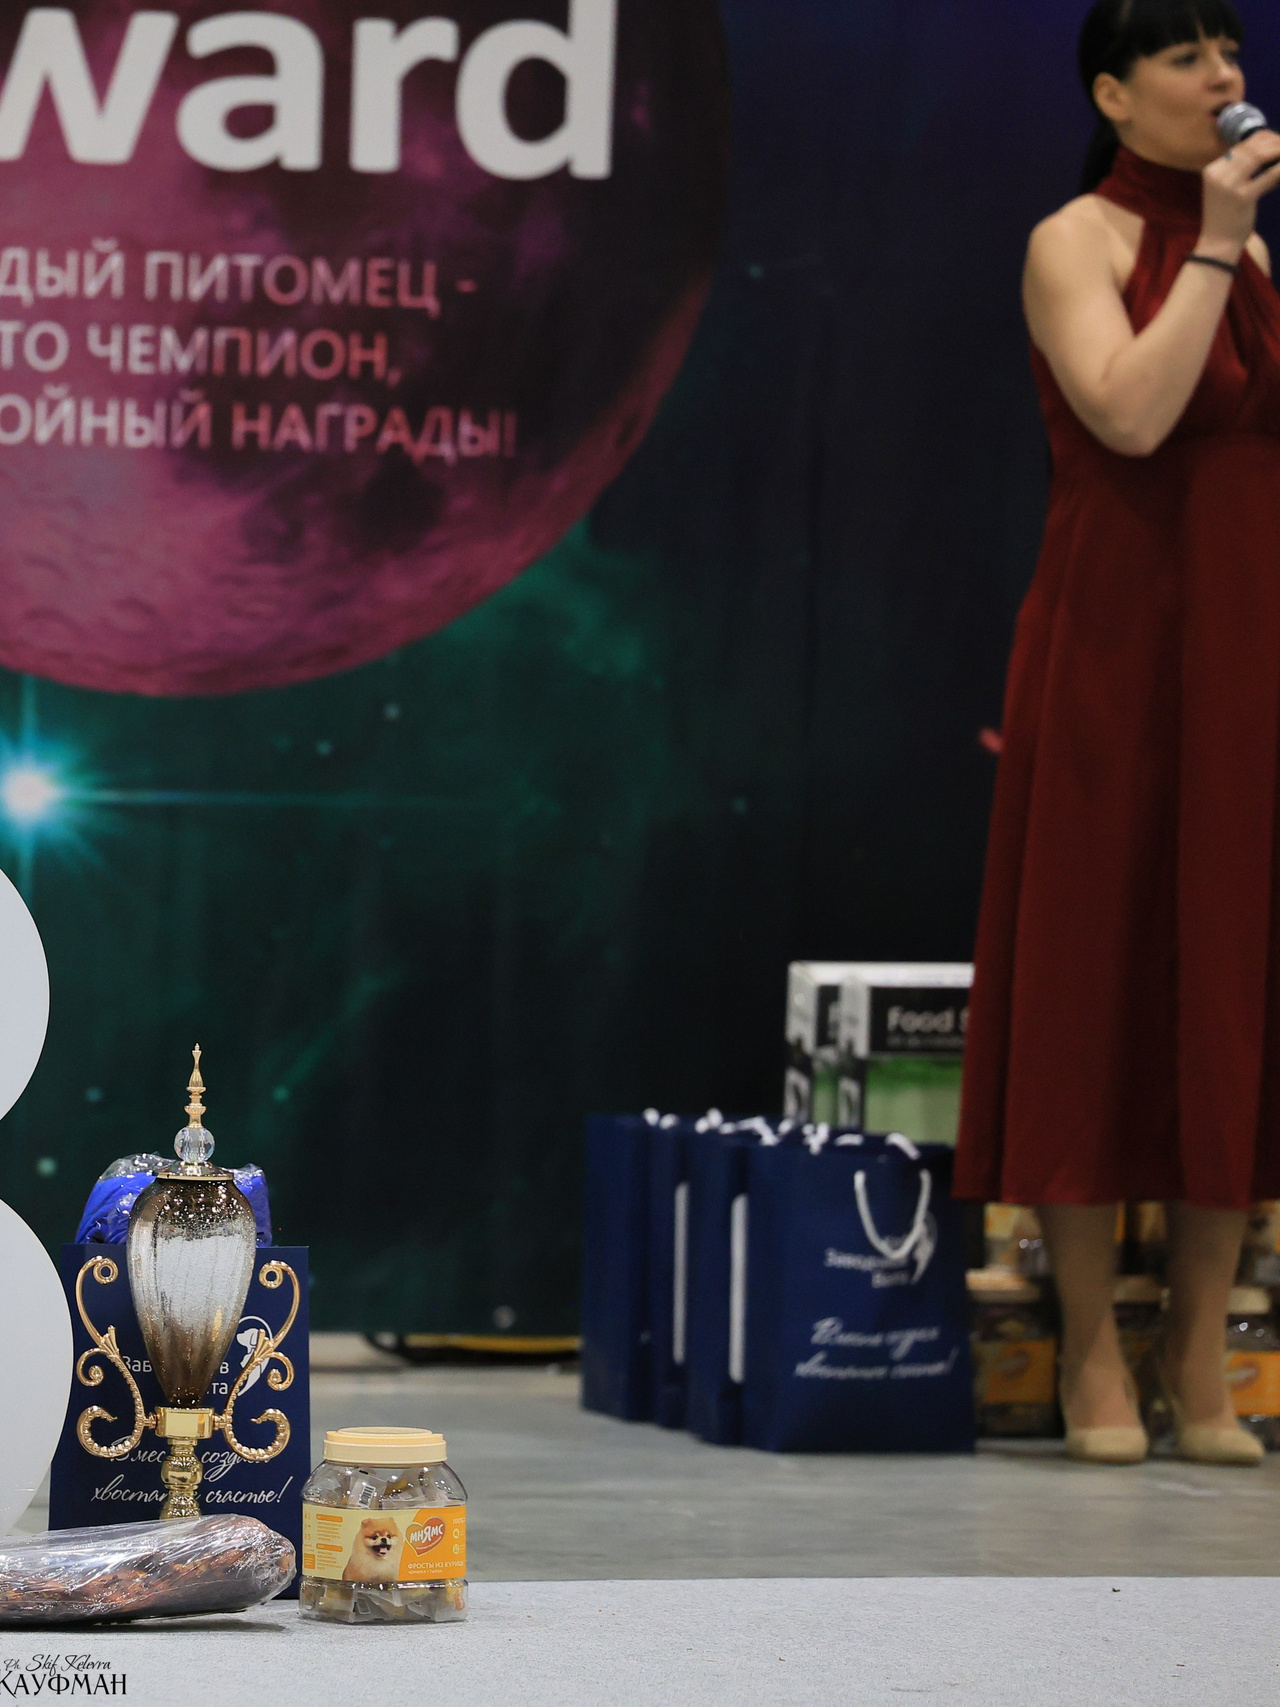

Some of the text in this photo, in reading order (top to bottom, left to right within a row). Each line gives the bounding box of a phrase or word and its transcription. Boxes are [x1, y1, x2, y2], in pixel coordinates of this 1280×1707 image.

[146, 254, 440, 315] ПИТОМЕЦ
[88, 323, 401, 386] ЧЕМПИОН,
[232, 404, 518, 459] НАГРАДЫ!
[887, 1005, 955, 1033] Food
